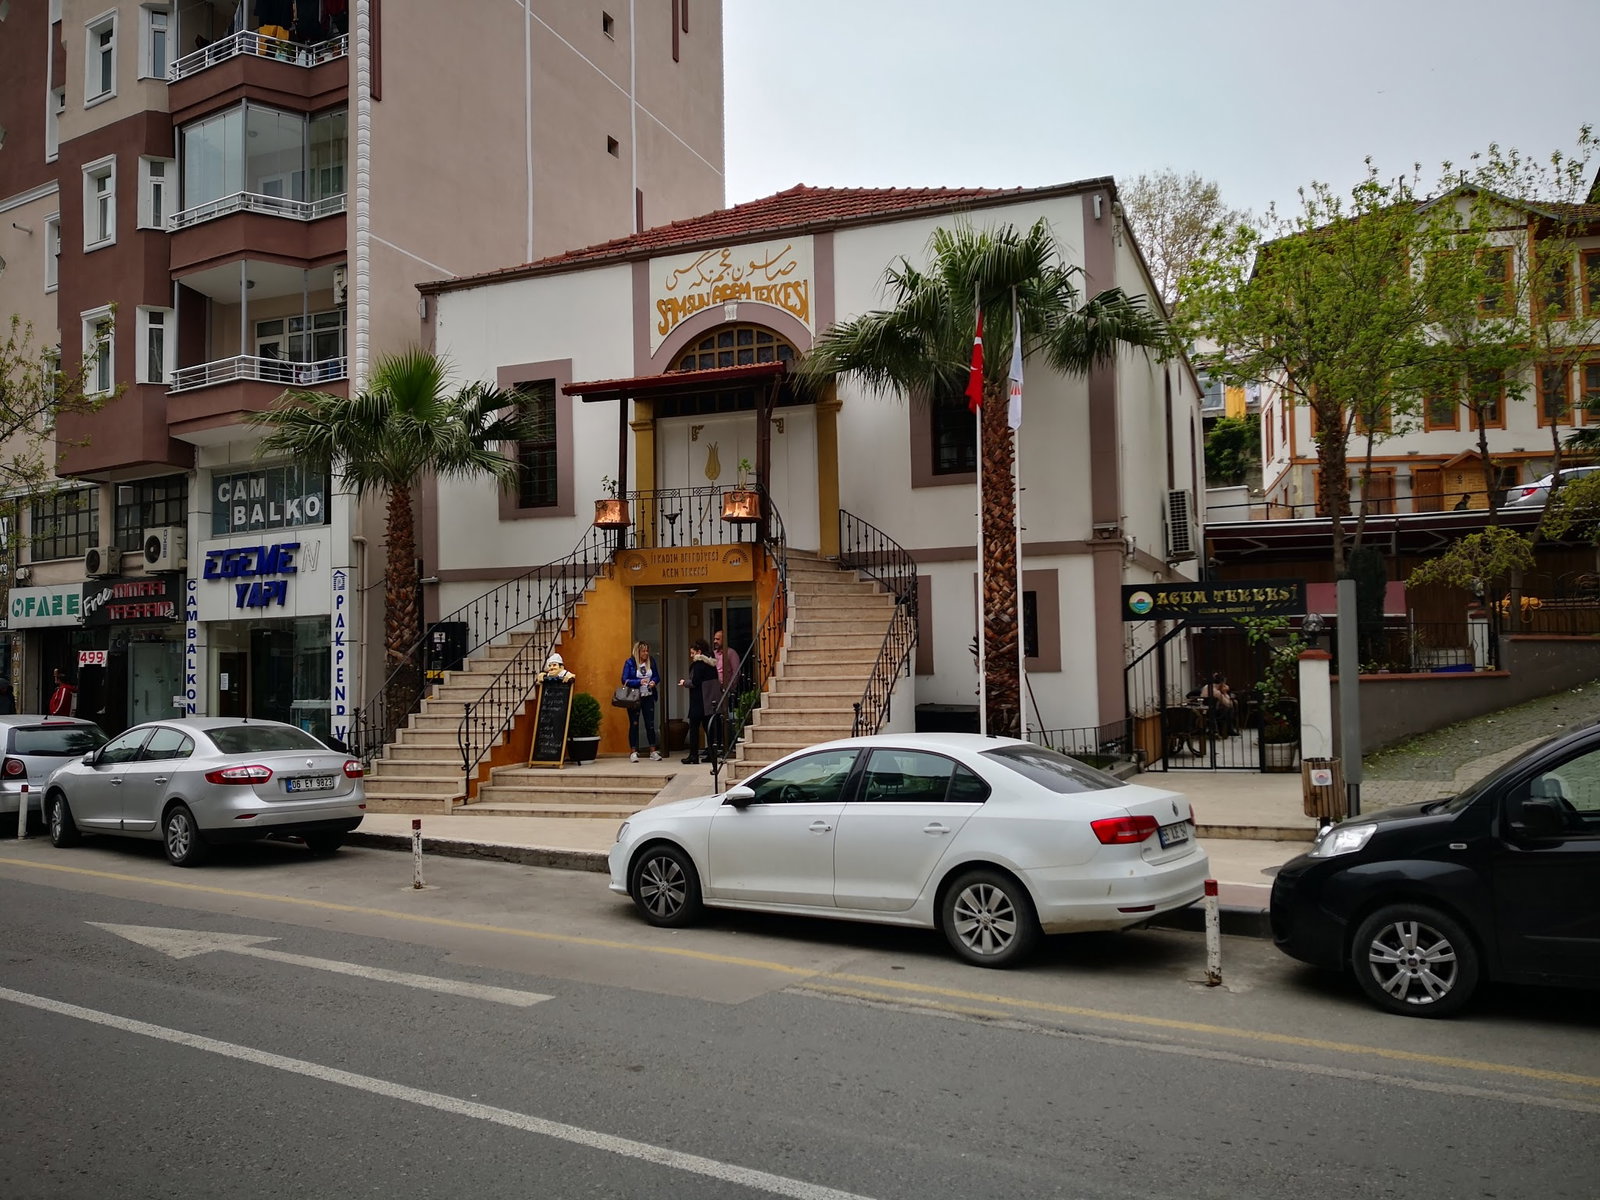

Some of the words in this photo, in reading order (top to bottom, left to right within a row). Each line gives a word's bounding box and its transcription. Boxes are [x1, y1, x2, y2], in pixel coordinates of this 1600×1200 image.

[656, 292, 710, 335] SAMSUN
[712, 281, 751, 304] ACEM
[218, 478, 265, 502] CAM
[233, 496, 320, 526] BALKO
[83, 588, 113, 616] Free
[186, 580, 198, 621] CAM
[235, 580, 288, 608] YAPI
[1156, 591, 1208, 605] ACEM
[187, 628, 197, 714] BALKON
[292, 780, 301, 788] 06
[305, 779, 313, 787] EY
